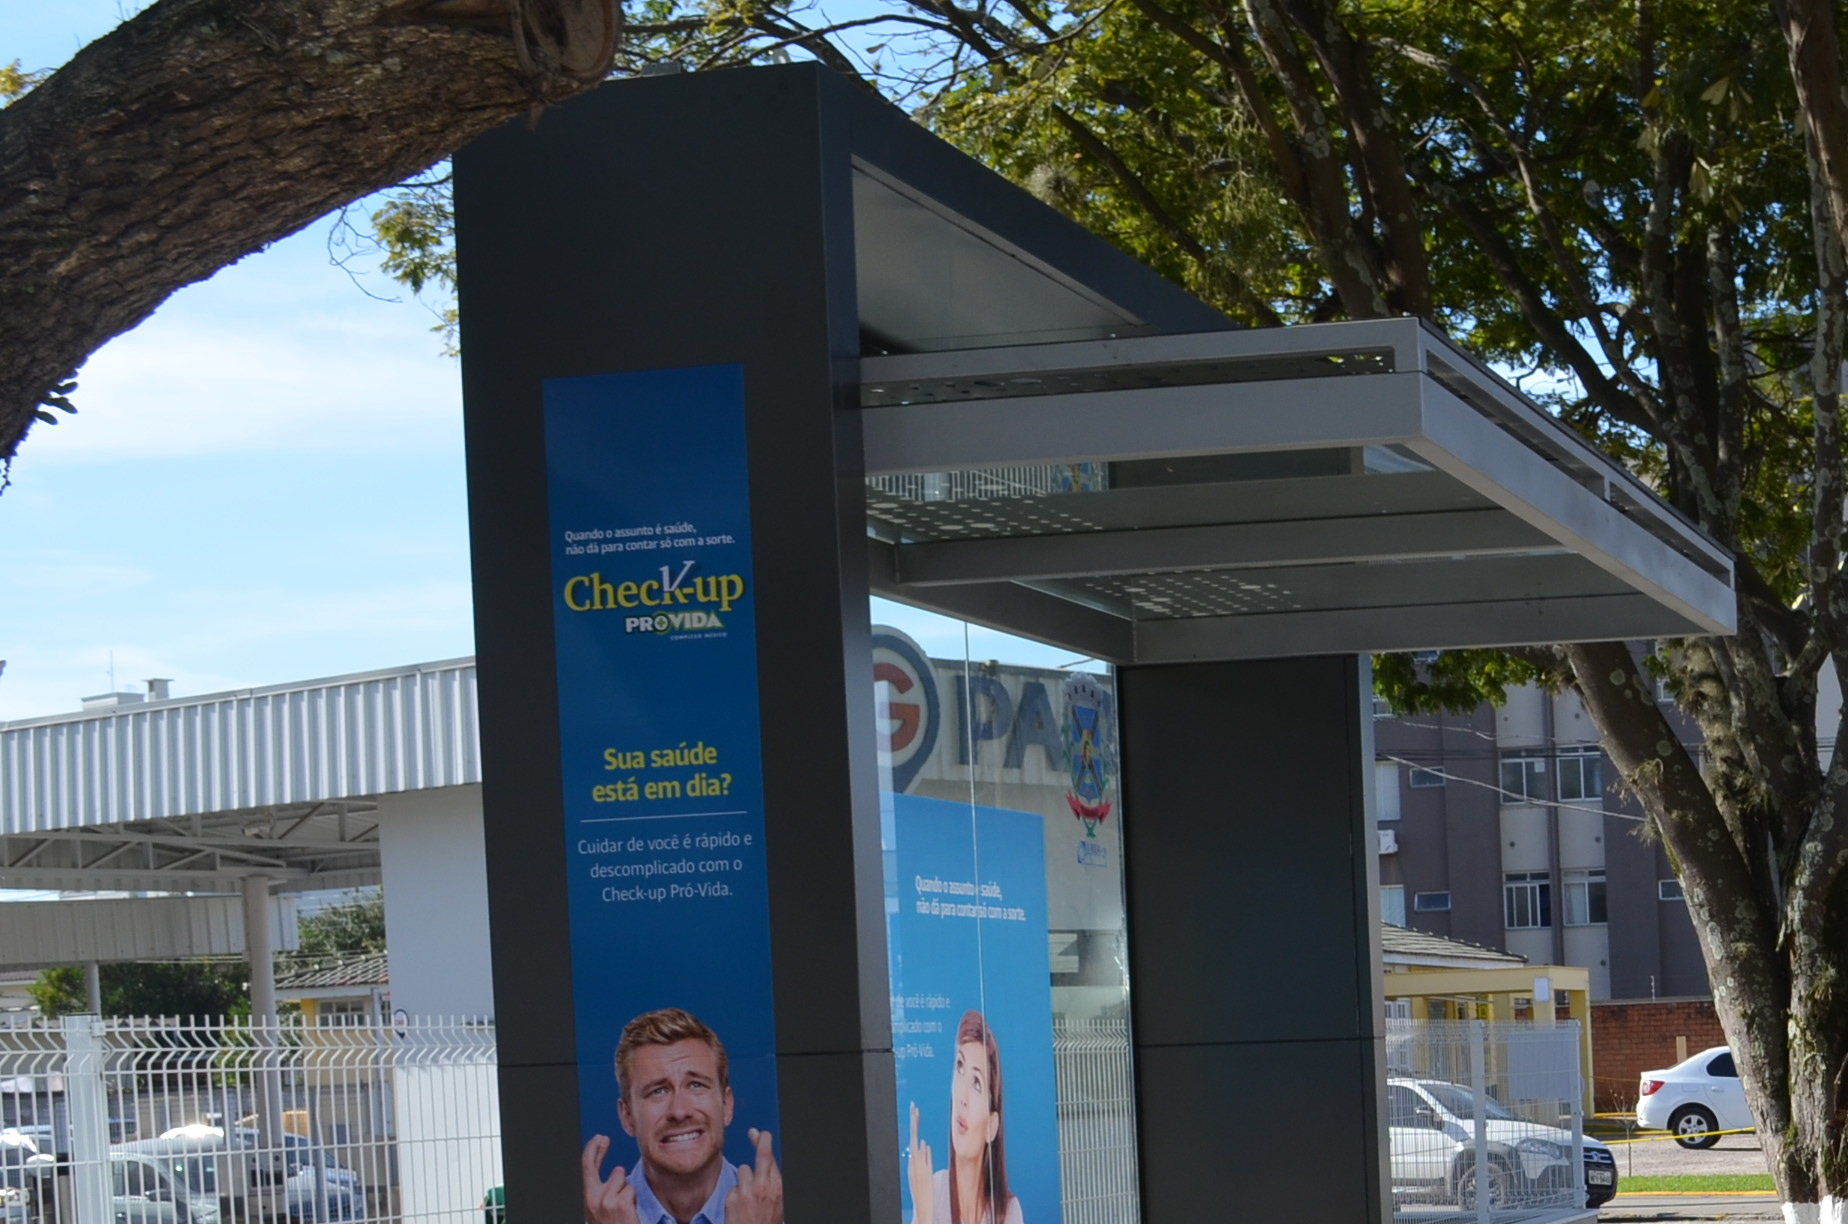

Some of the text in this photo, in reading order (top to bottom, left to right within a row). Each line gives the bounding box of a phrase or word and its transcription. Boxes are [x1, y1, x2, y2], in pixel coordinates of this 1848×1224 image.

[565, 522, 697, 543] Quando o assunto é saúde,
[565, 533, 736, 555] não dá para contar só com a sorte.
[603, 741, 718, 771] Sua saúde
[592, 772, 733, 803] está em dia?
[578, 831, 753, 855] Cuidar de você é rápido e
[590, 857, 743, 879] descomplicado com o
[602, 881, 734, 903] Check-up Pró-Vida.
[915, 875, 943, 895] Quando
